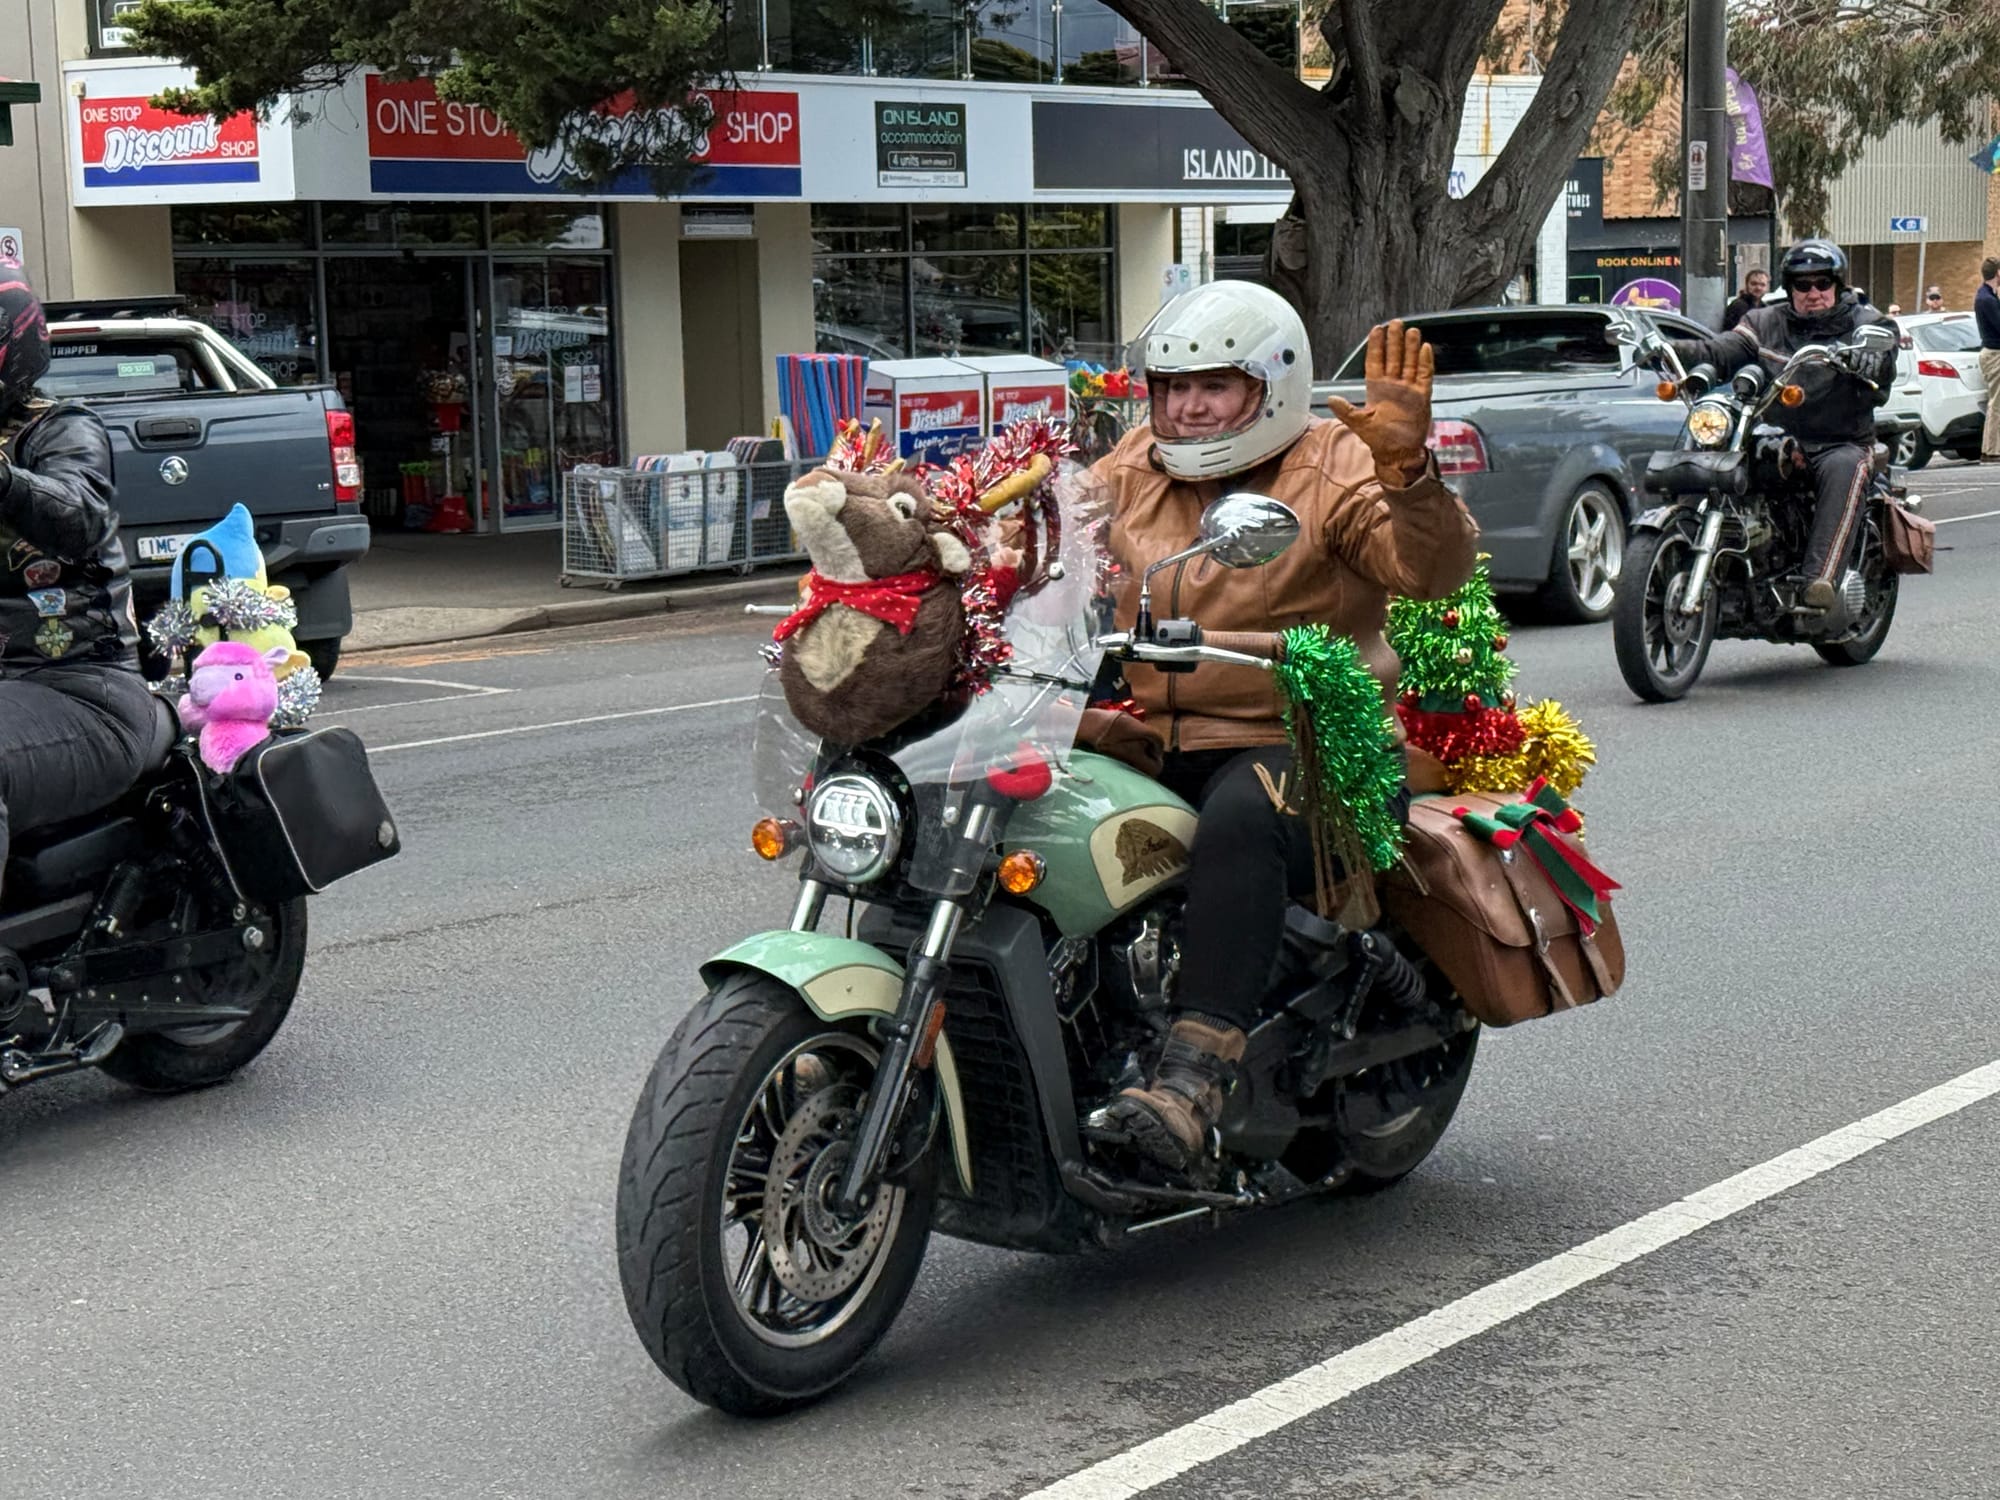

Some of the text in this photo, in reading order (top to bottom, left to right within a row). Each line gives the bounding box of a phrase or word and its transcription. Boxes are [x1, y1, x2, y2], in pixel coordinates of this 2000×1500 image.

[83, 106, 142, 123] ONE STOP
[376, 99, 508, 136] ONE STO
[883, 109, 959, 126] ON ISLAND
[727, 112, 793, 143] SHOP
[880, 131, 962, 144] accommodation
[220, 140, 256, 157] SHOP
[900, 154, 920, 167] units
[1183, 149, 1257, 178] ISLAND
[1597, 258, 1628, 268] BOOK
[1630, 256, 1672, 267] ONLINE
